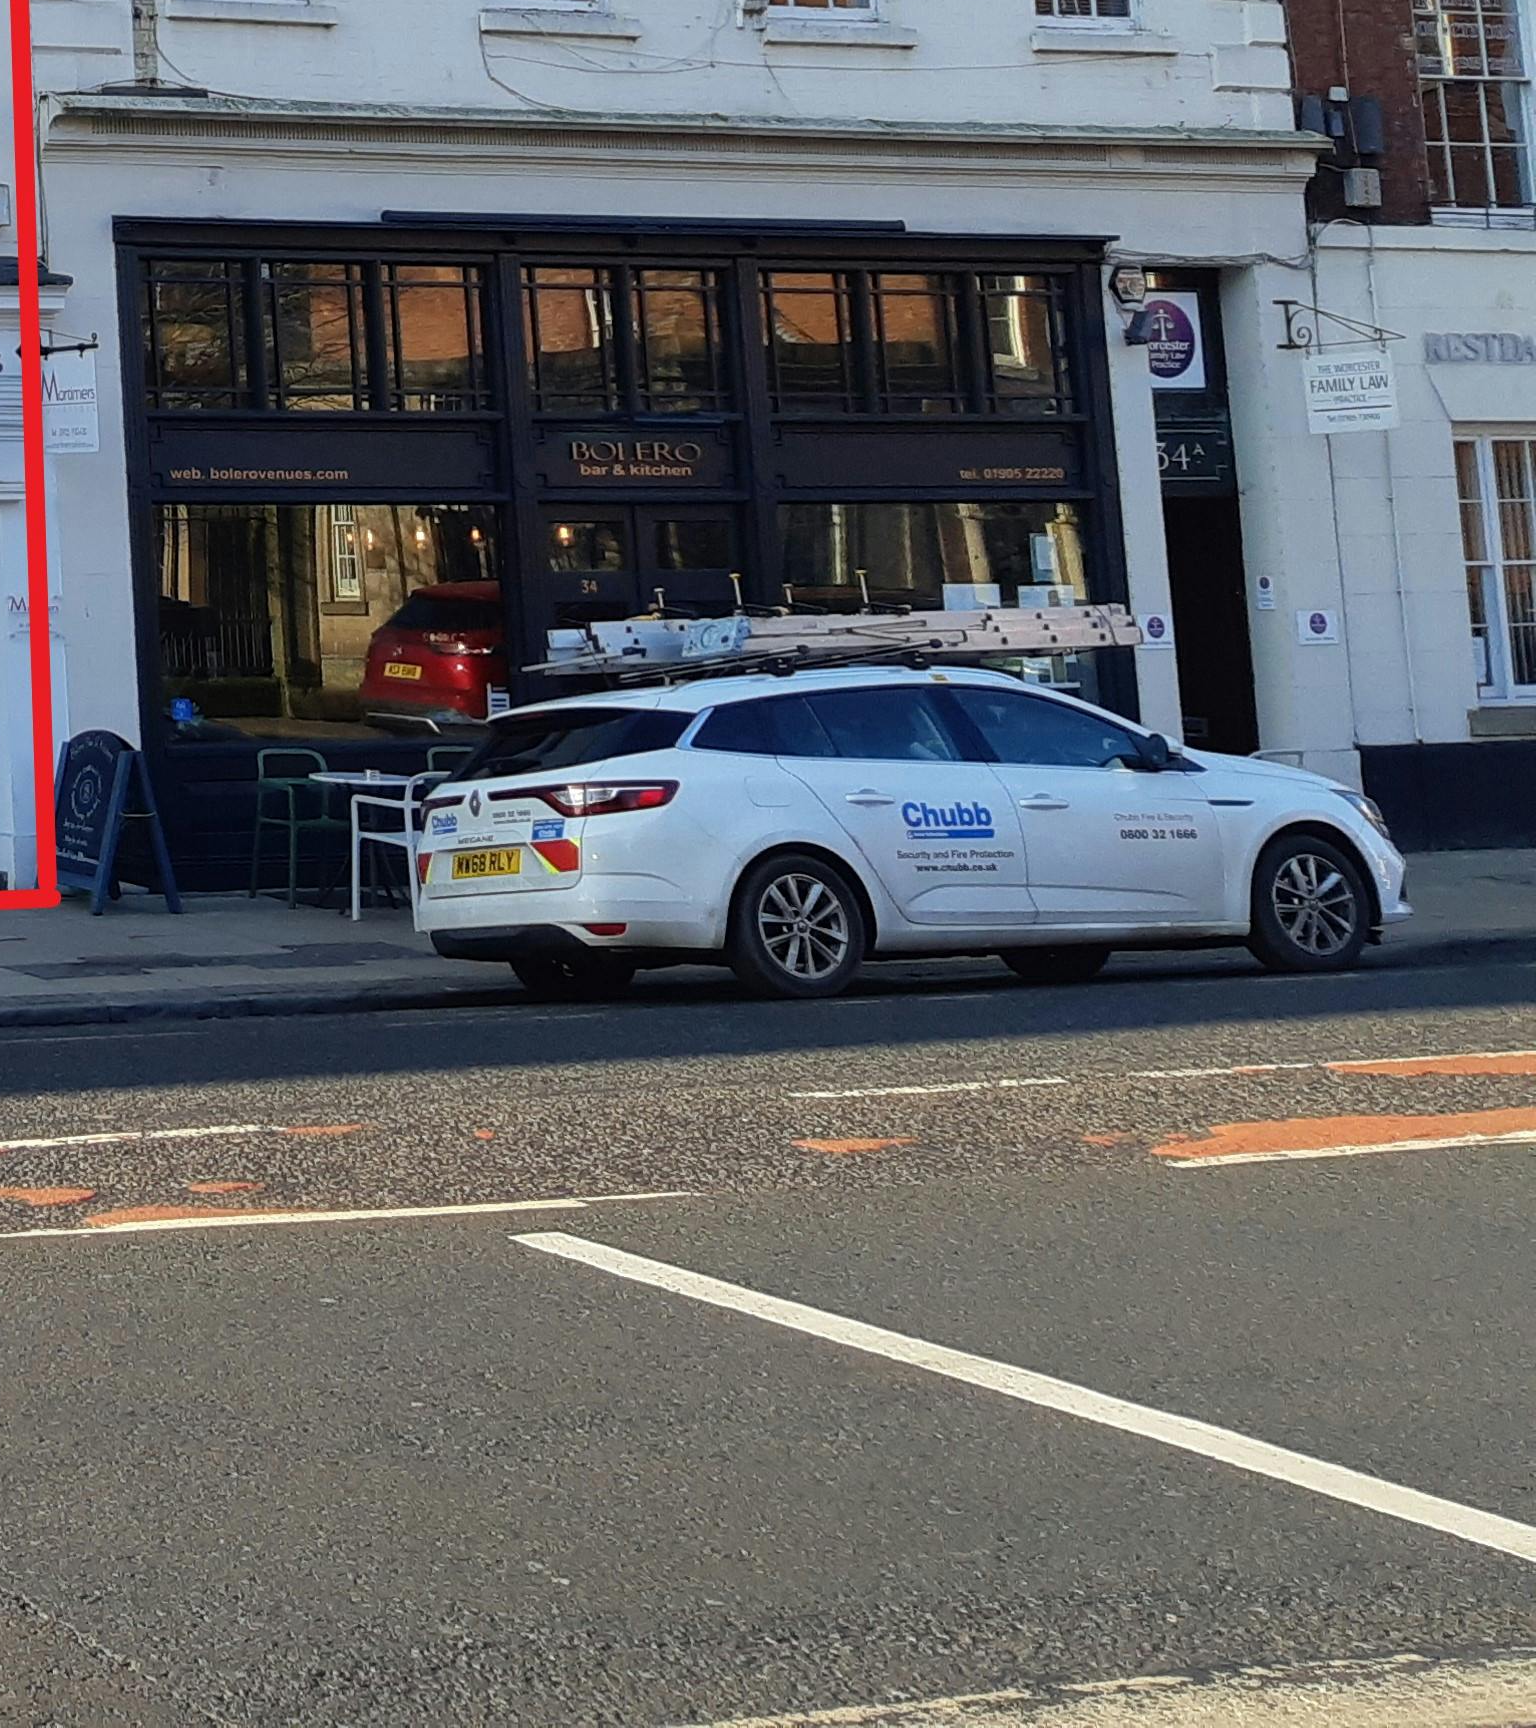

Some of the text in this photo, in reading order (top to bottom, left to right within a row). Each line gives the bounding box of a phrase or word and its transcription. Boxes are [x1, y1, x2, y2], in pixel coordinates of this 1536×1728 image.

[1149, 339, 1190, 351] orcester
[1310, 374, 1388, 394] FAMILY LAW
[571, 440, 701, 462] BOLERO
[170, 466, 349, 481] web. bolerovenues.com
[580, 463, 692, 476] bar & kitchen
[983, 467, 1022, 479] 01905
[581, 579, 598, 593] 34
[432, 813, 458, 828] Chubb
[902, 801, 992, 827] Chubb
[1120, 828, 1198, 839] 0800 32 1666
[489, 850, 515, 872] RLY
[897, 849, 1015, 861] Security and Fire Protection
